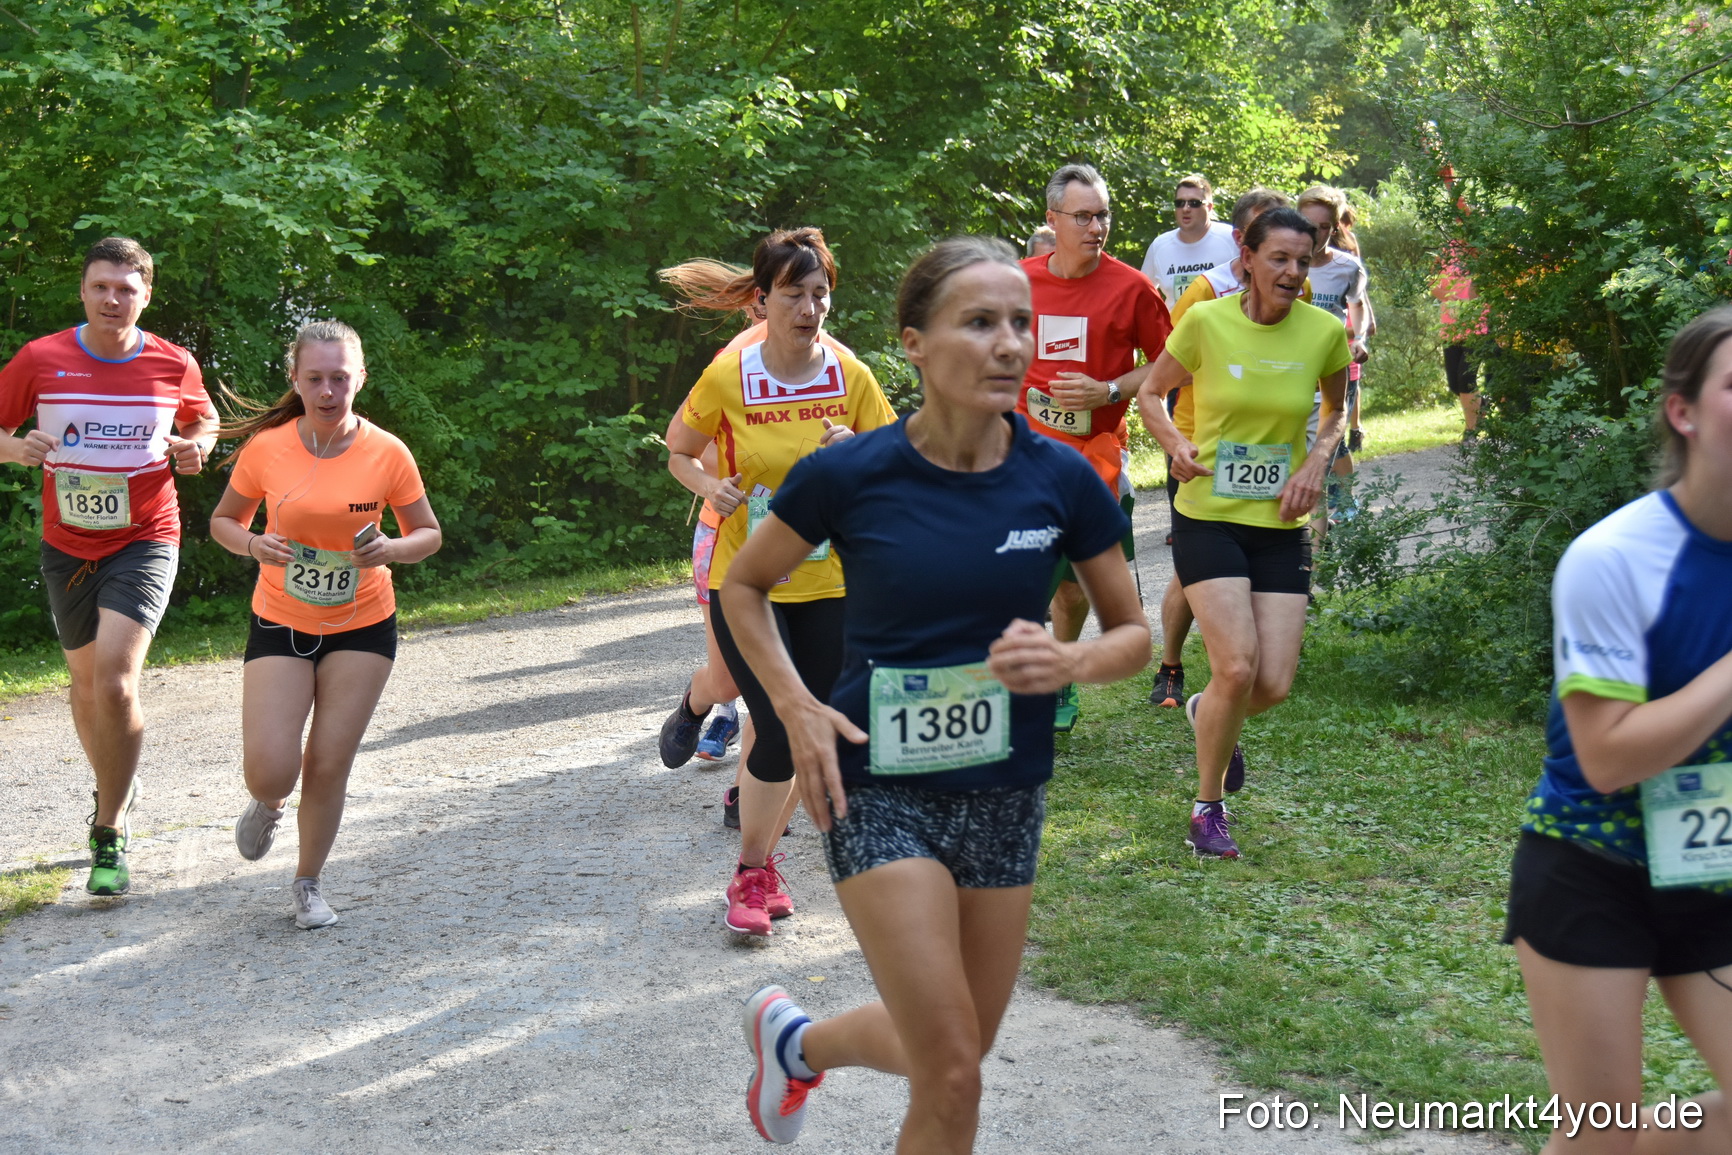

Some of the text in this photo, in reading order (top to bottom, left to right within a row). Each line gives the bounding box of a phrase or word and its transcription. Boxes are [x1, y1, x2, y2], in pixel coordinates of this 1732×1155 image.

[1177, 262, 1214, 274] MAGNA
[1054, 342, 1070, 350] DEHN
[745, 403, 848, 425] MAX BÖGL
[1038, 408, 1076, 425] 478
[84, 422, 156, 441] Petry
[1225, 462, 1280, 484] 1208
[65, 492, 118, 514] 1830
[348, 502, 378, 512] THULE
[292, 564, 350, 590] 2318
[294, 583, 316, 594] Weigert
[890, 699, 992, 744] 1380
[957, 738, 983, 749] Karin
